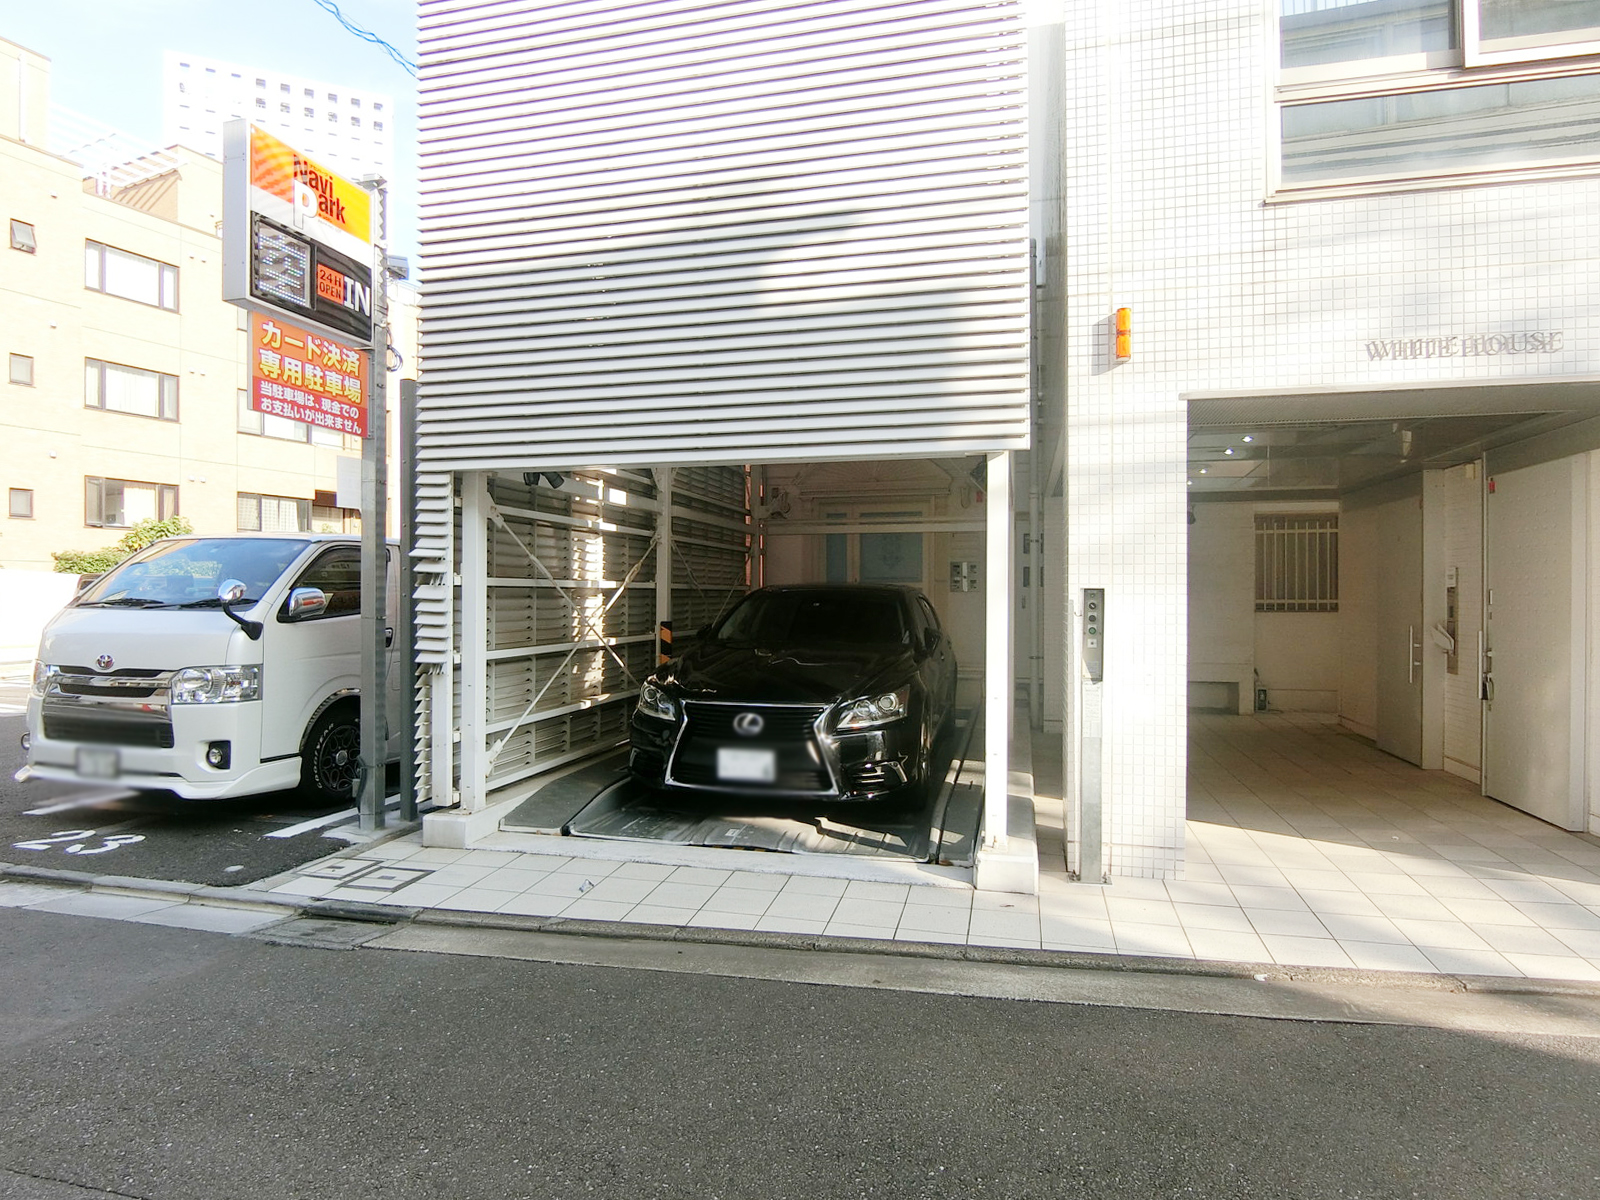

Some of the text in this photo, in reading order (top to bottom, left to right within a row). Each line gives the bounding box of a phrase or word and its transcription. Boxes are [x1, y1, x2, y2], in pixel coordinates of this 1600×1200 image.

[293, 154, 334, 199] Navi
[319, 281, 342, 300] OPEN
[343, 275, 371, 317] IN
[261, 320, 361, 376] カード決済
[1366, 331, 1564, 361] WHITE HOUSE
[259, 348, 362, 403] 専用駐車場
[260, 380, 360, 420] 当駐車場は、現金での
[260, 397, 362, 435] お支払いが出来ません
[12, 829, 147, 855] 23
